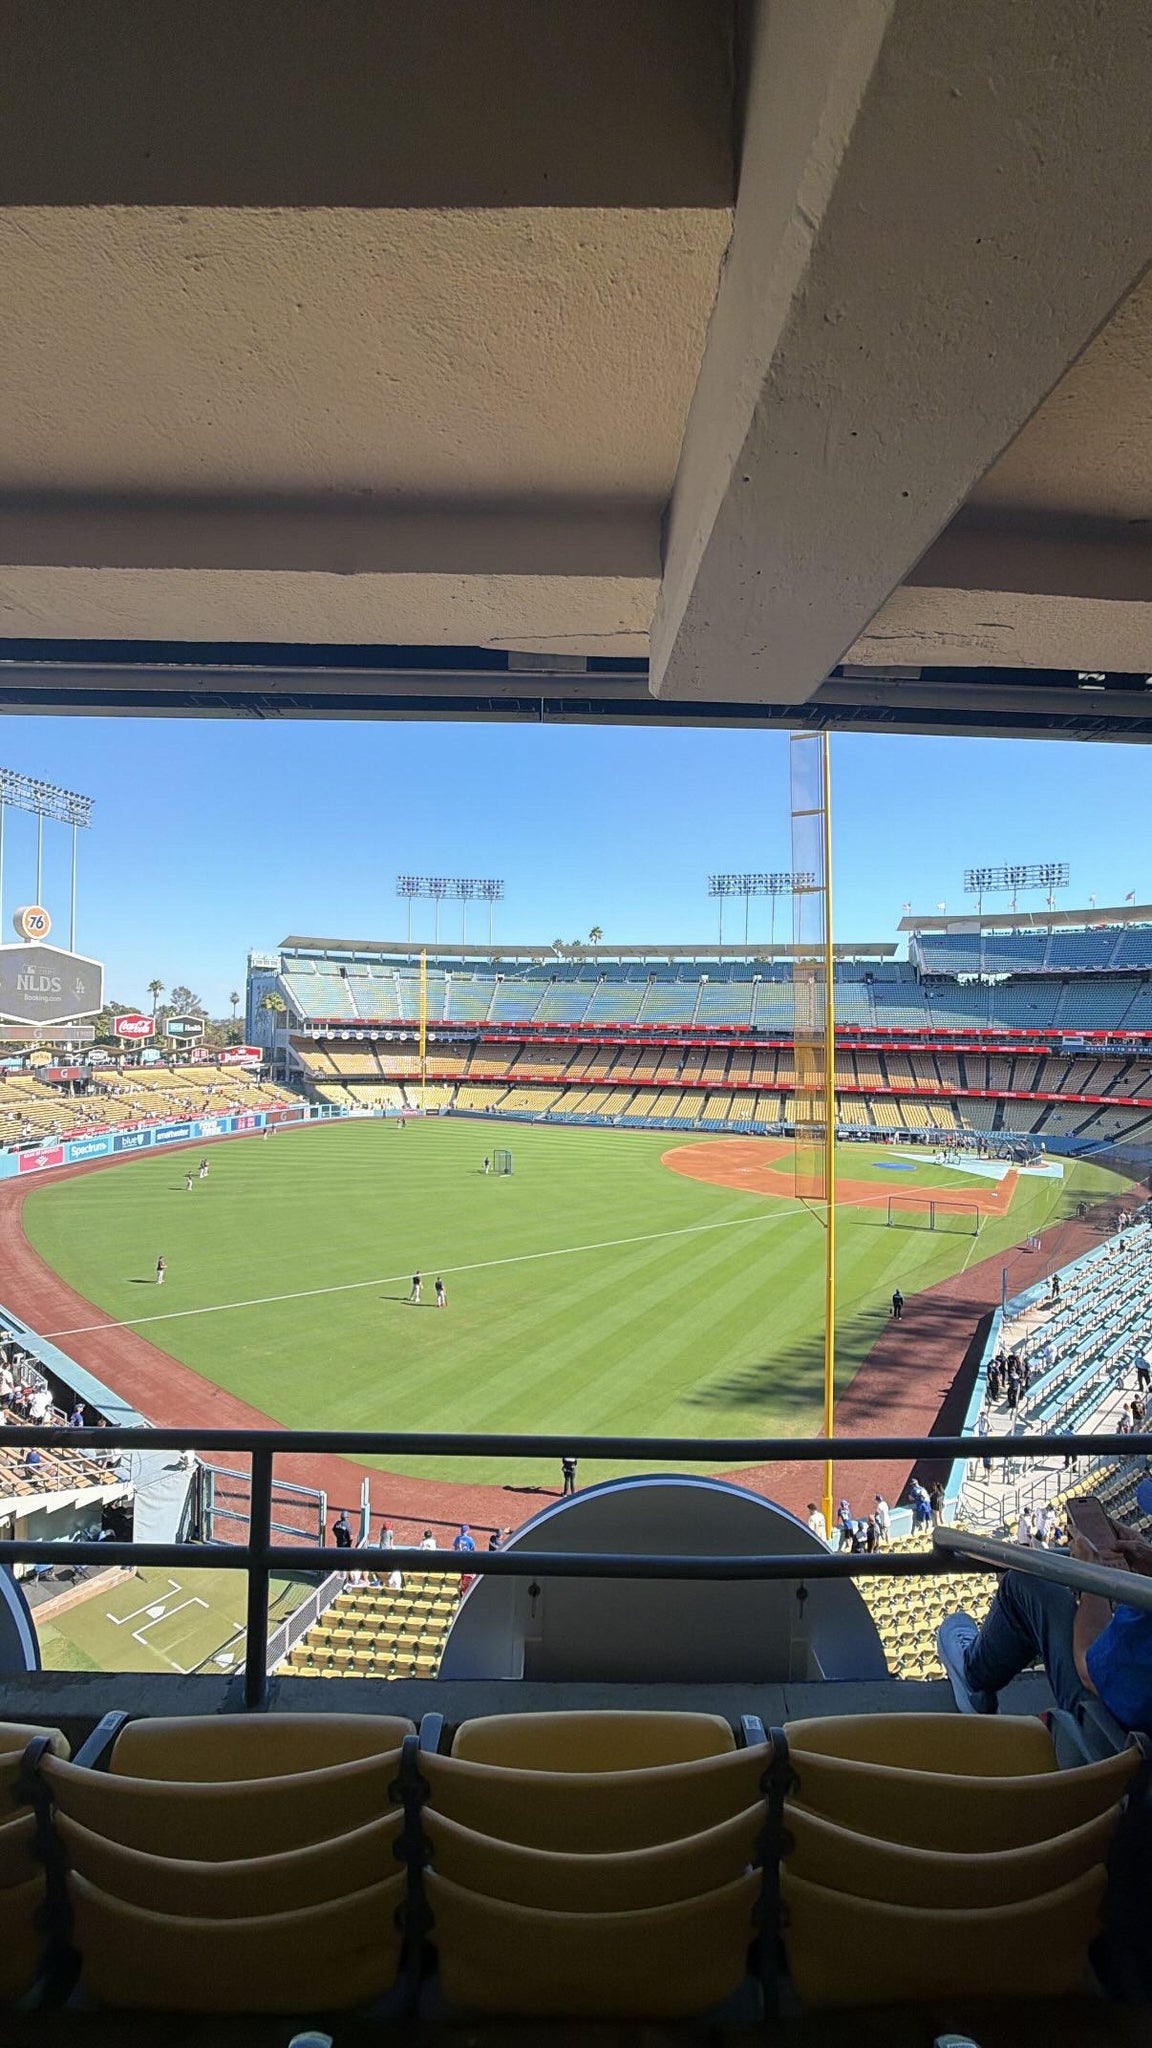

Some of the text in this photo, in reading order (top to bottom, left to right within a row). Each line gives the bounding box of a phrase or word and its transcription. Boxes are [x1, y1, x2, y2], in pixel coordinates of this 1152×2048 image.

[29, 915, 44, 930] 76
[17, 974, 62, 992] NLDS
[24, 993, 62, 1004] Booking.com
[60, 1069, 68, 1078] G
[121, 1136, 138, 1146] blue
[71, 1143, 103, 1158] Spectrum
